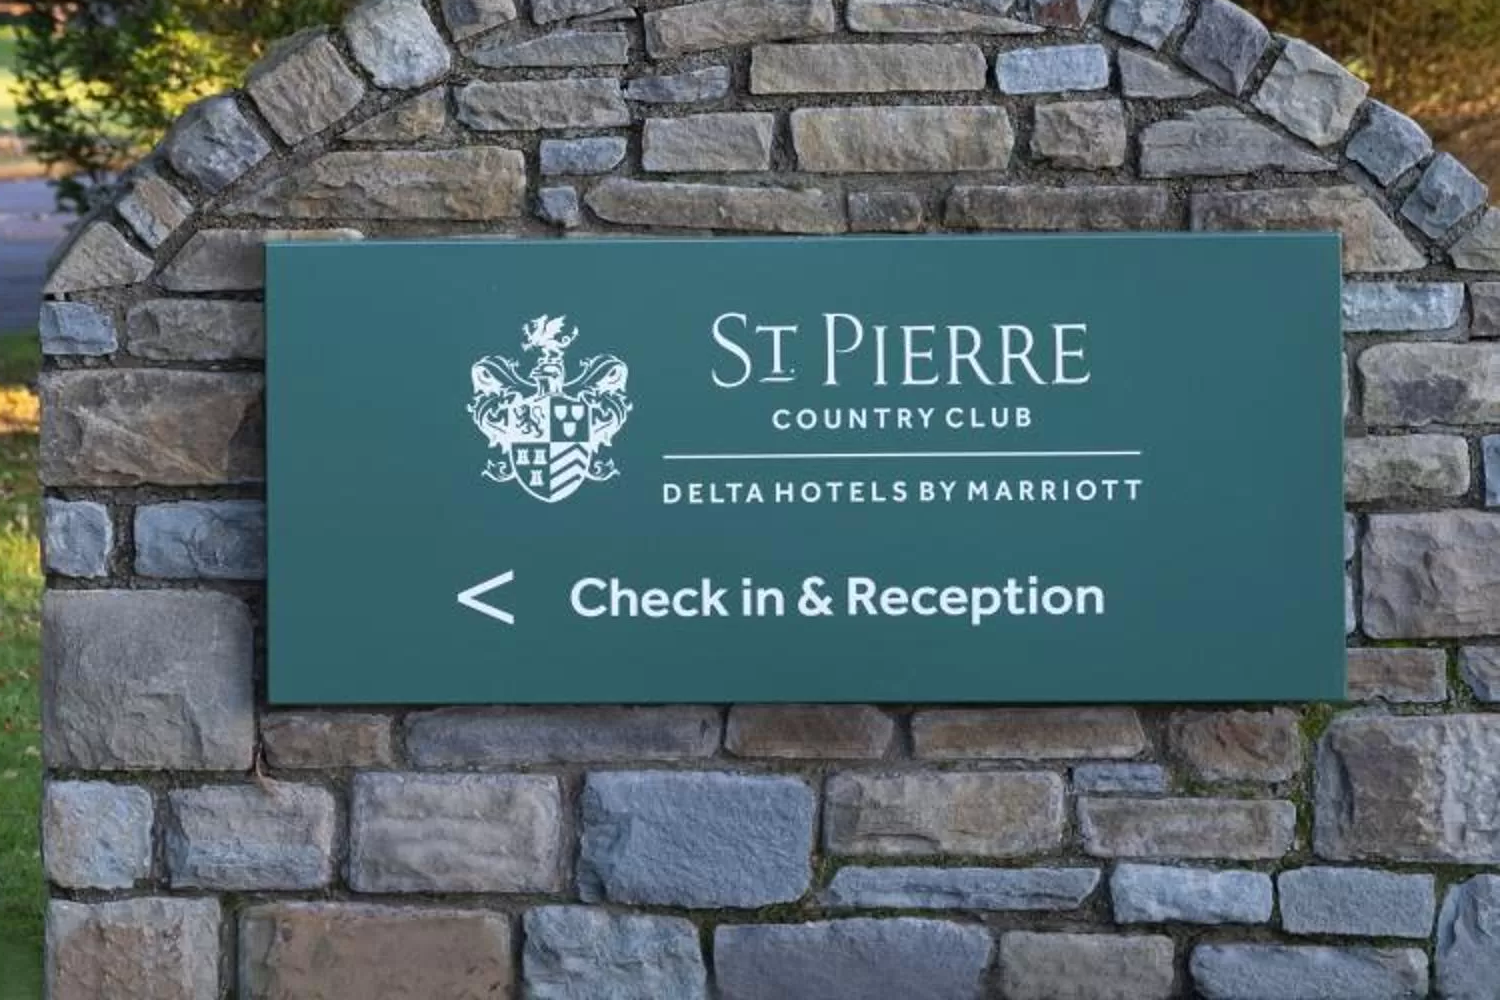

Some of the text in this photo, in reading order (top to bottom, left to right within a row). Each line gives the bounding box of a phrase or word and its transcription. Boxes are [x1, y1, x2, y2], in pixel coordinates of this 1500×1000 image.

[822, 312, 1092, 386] PIERRE
[771, 406, 1032, 431] COUNTRY CLUB
[662, 478, 1143, 505] DELTA HOTELS BY MARRIOTT
[569, 574, 1105, 627] Check in & Reception
